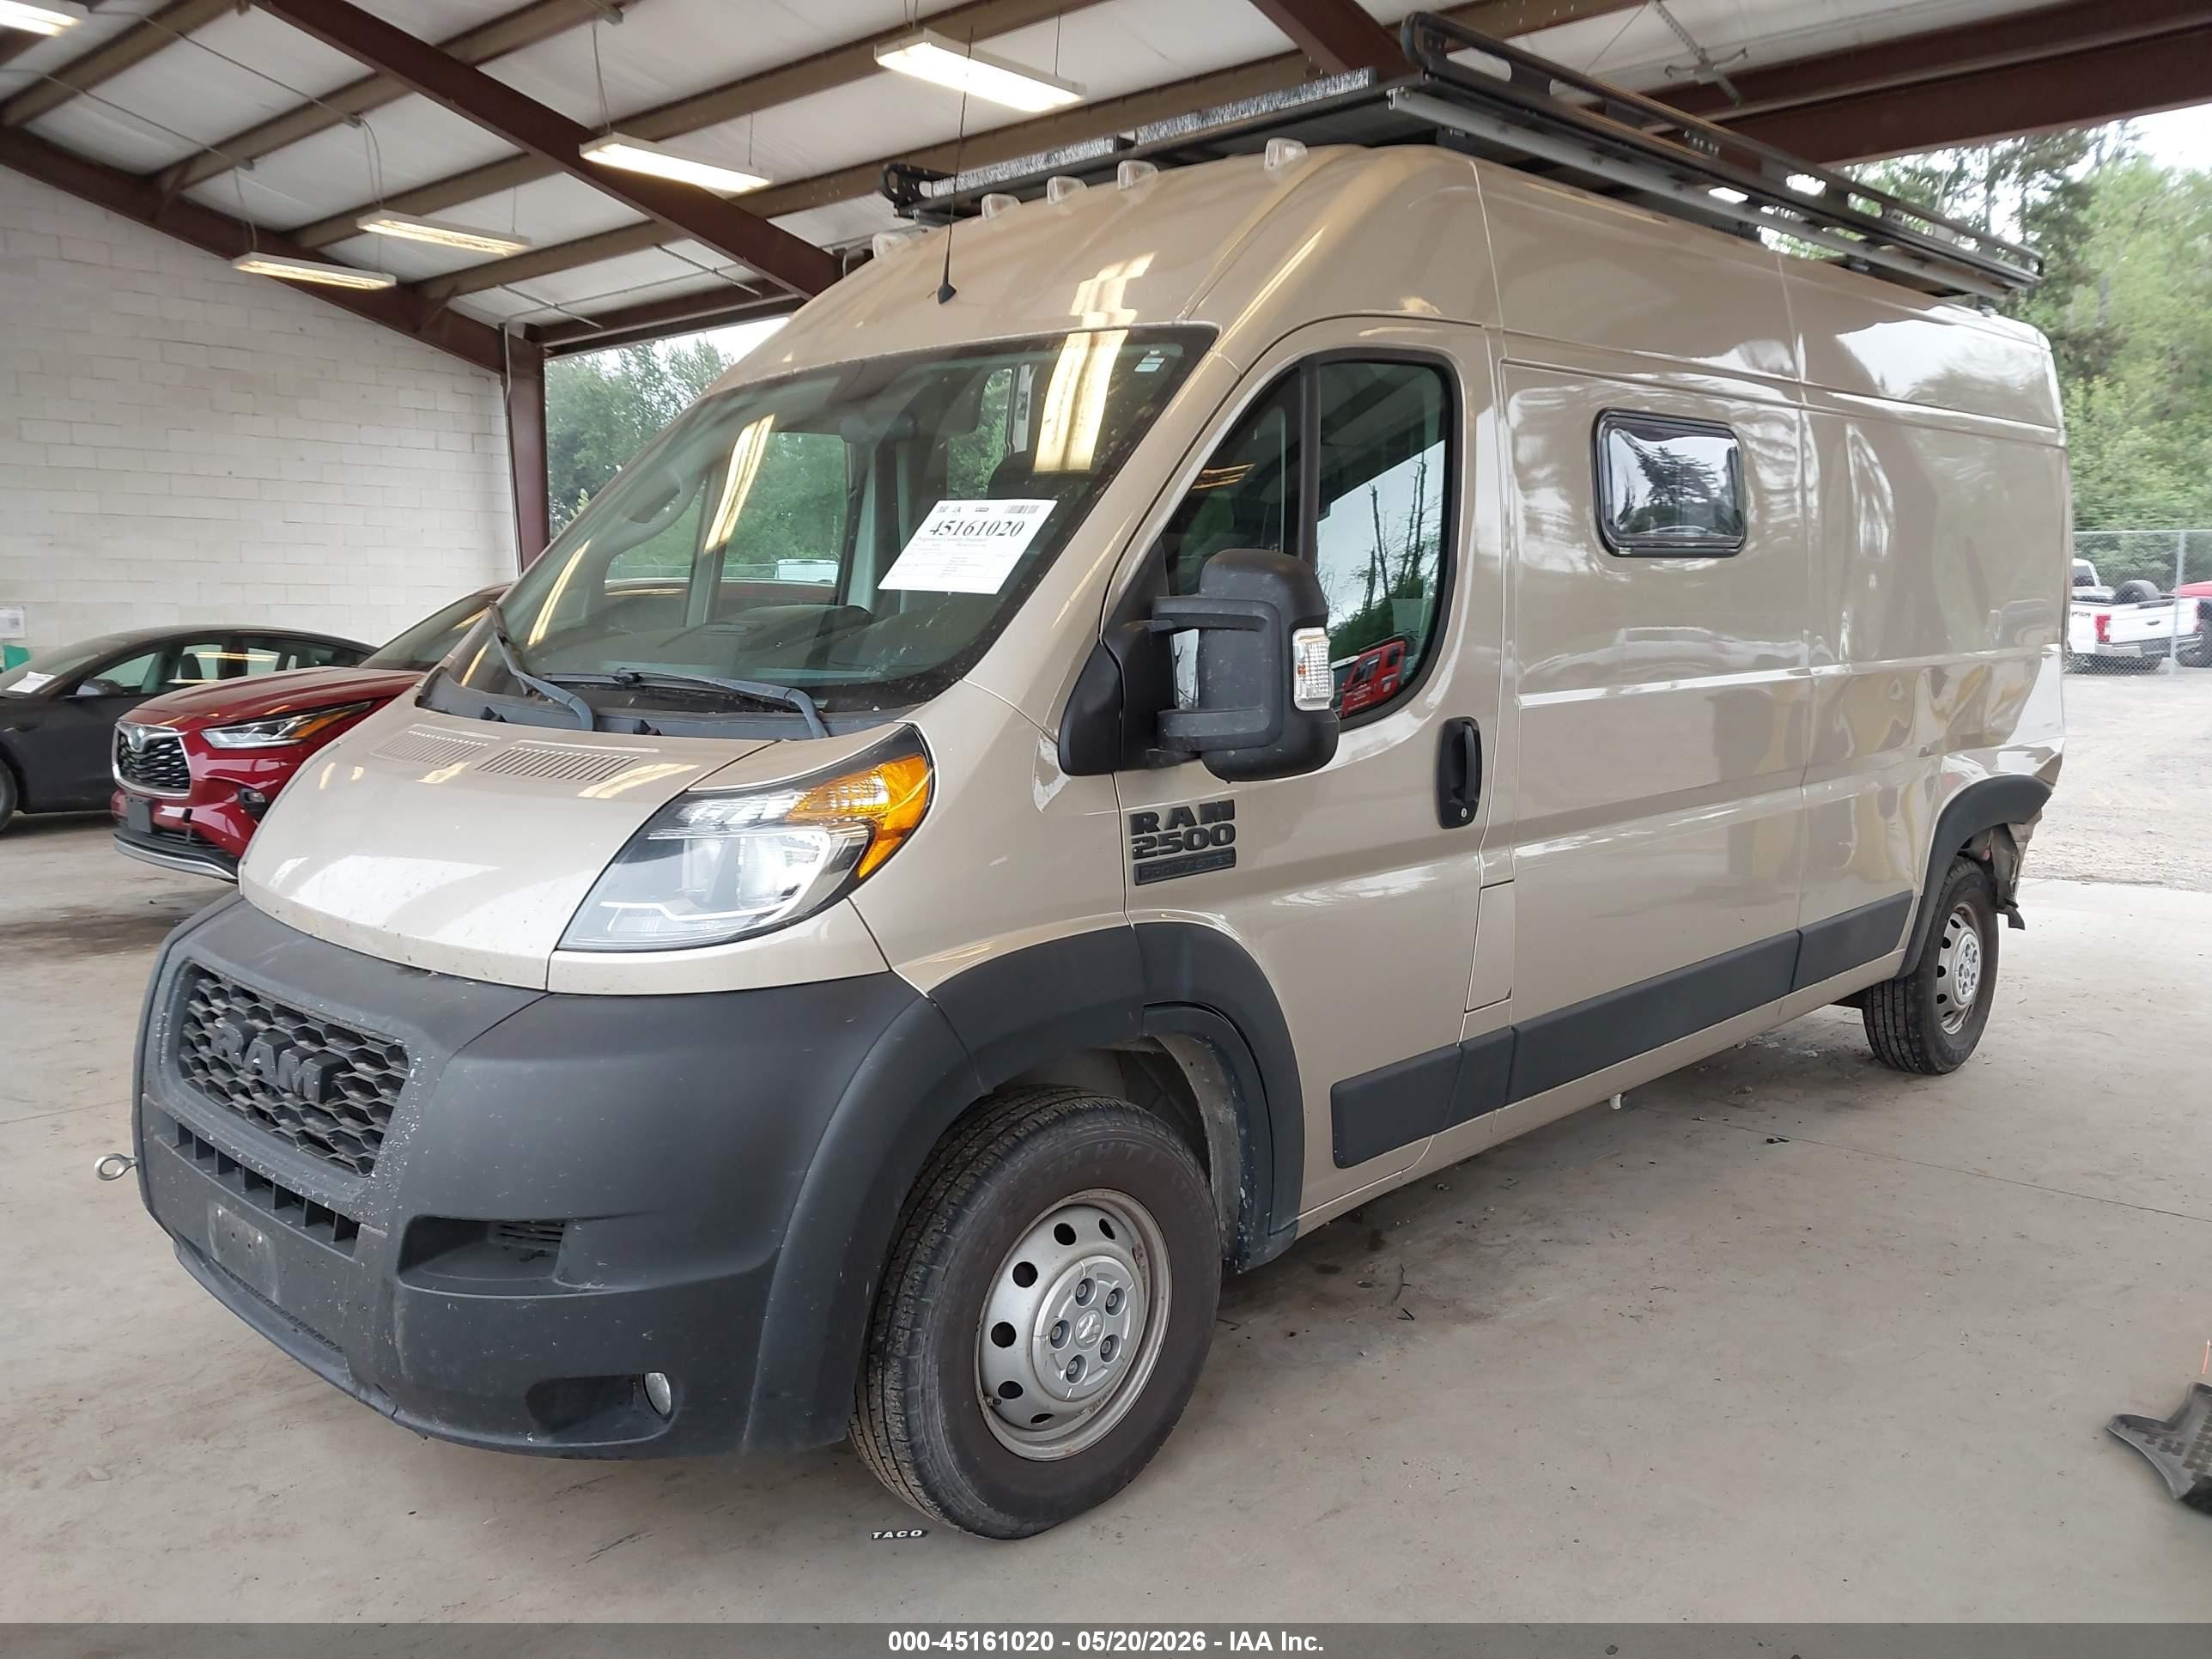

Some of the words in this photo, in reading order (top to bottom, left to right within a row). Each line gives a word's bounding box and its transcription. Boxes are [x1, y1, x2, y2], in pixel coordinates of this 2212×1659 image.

[928, 520, 1025, 538] 45161020
[1129, 799, 1236, 836] RAM
[1131, 823, 1237, 860] 2500
[210, 1017, 331, 1105] RAM
[872, 1529, 923, 1539] TACO
